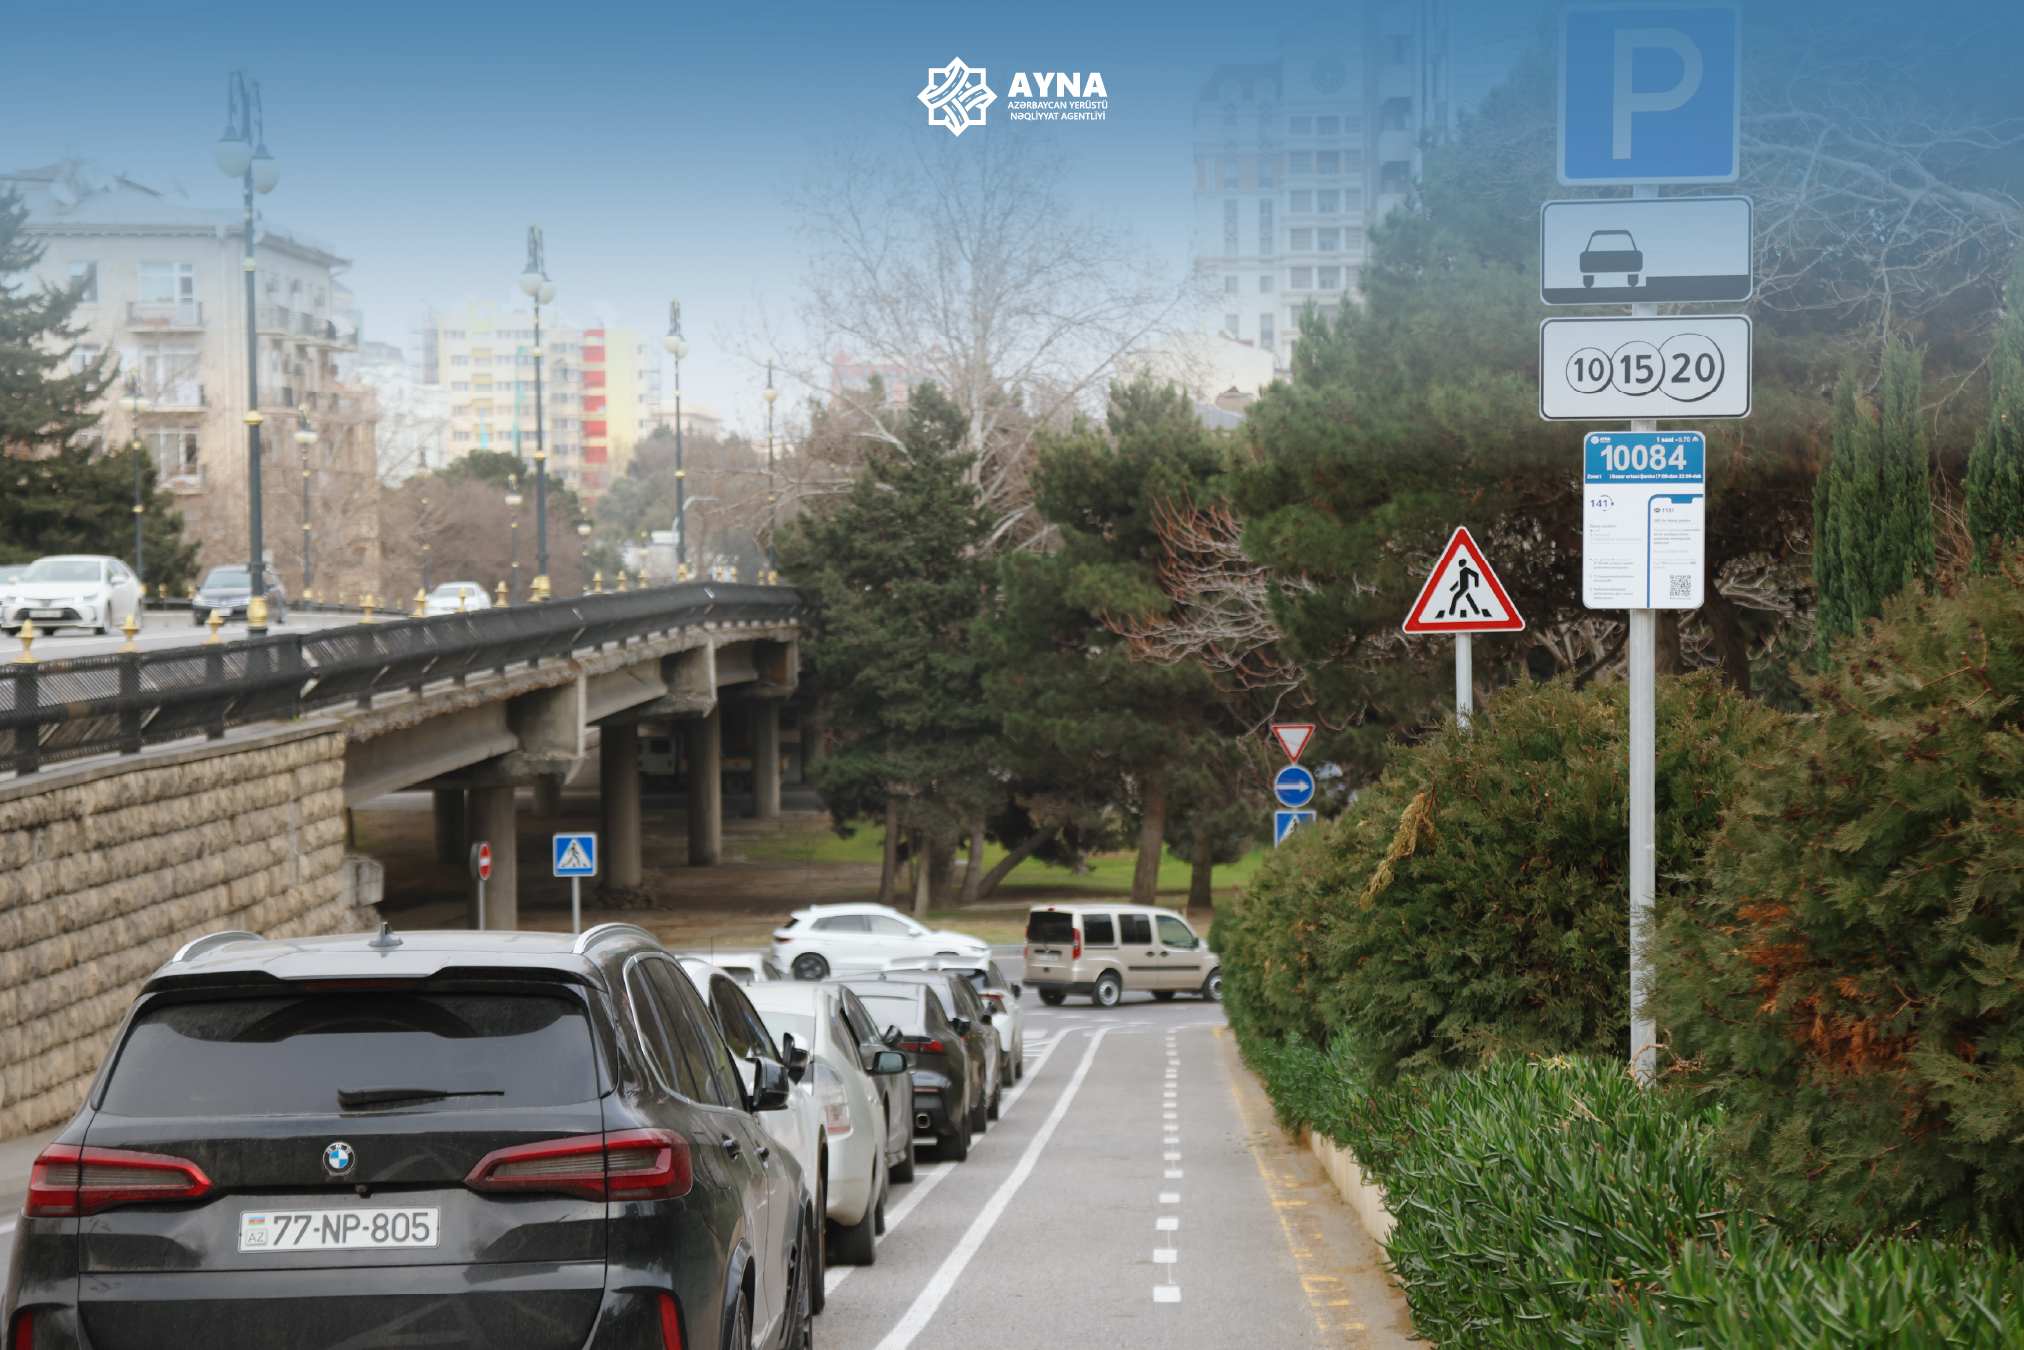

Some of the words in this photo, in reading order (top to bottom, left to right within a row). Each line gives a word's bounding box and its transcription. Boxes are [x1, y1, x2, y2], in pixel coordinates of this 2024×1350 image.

[1612, 27, 1704, 160] P
[1573, 357, 1605, 382] 10
[1620, 354, 1654, 384] 15
[1670, 352, 1716, 383] 20
[1600, 444, 1687, 471] 10084
[1590, 499, 1608, 508] 141
[247, 1232, 264, 1243] AZ
[272, 1212, 430, 1246] 77-NP-805
